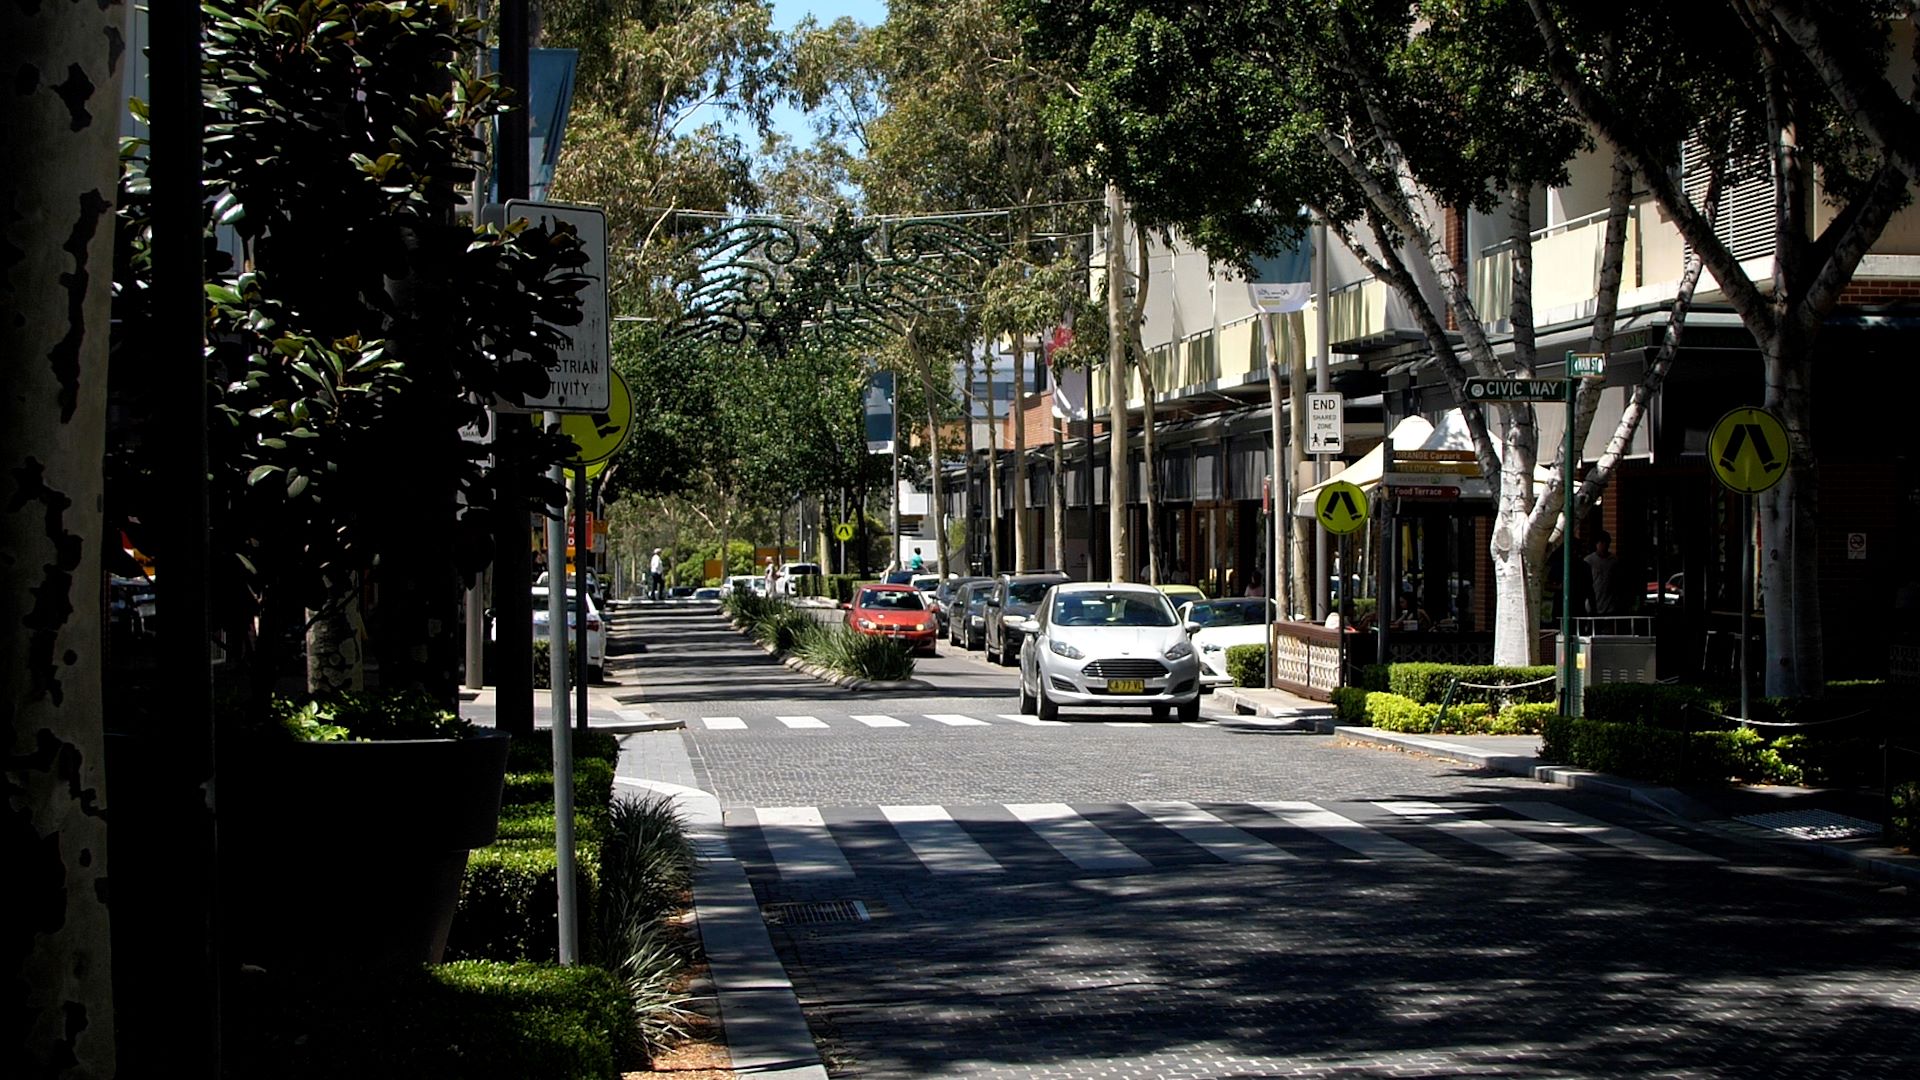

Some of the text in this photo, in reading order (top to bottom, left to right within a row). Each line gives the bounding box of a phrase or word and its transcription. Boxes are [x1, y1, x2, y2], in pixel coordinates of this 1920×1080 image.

[547, 359, 598, 374] ESTRIAN
[1577, 356, 1599, 371] MAIN ST
[550, 380, 590, 396] TIVITY
[1486, 381, 1559, 396] CIVIC WAY
[1313, 399, 1336, 410] END
[1395, 451, 1461, 461] ORANGE Carpark
[1394, 487, 1442, 496] Food Terrace
